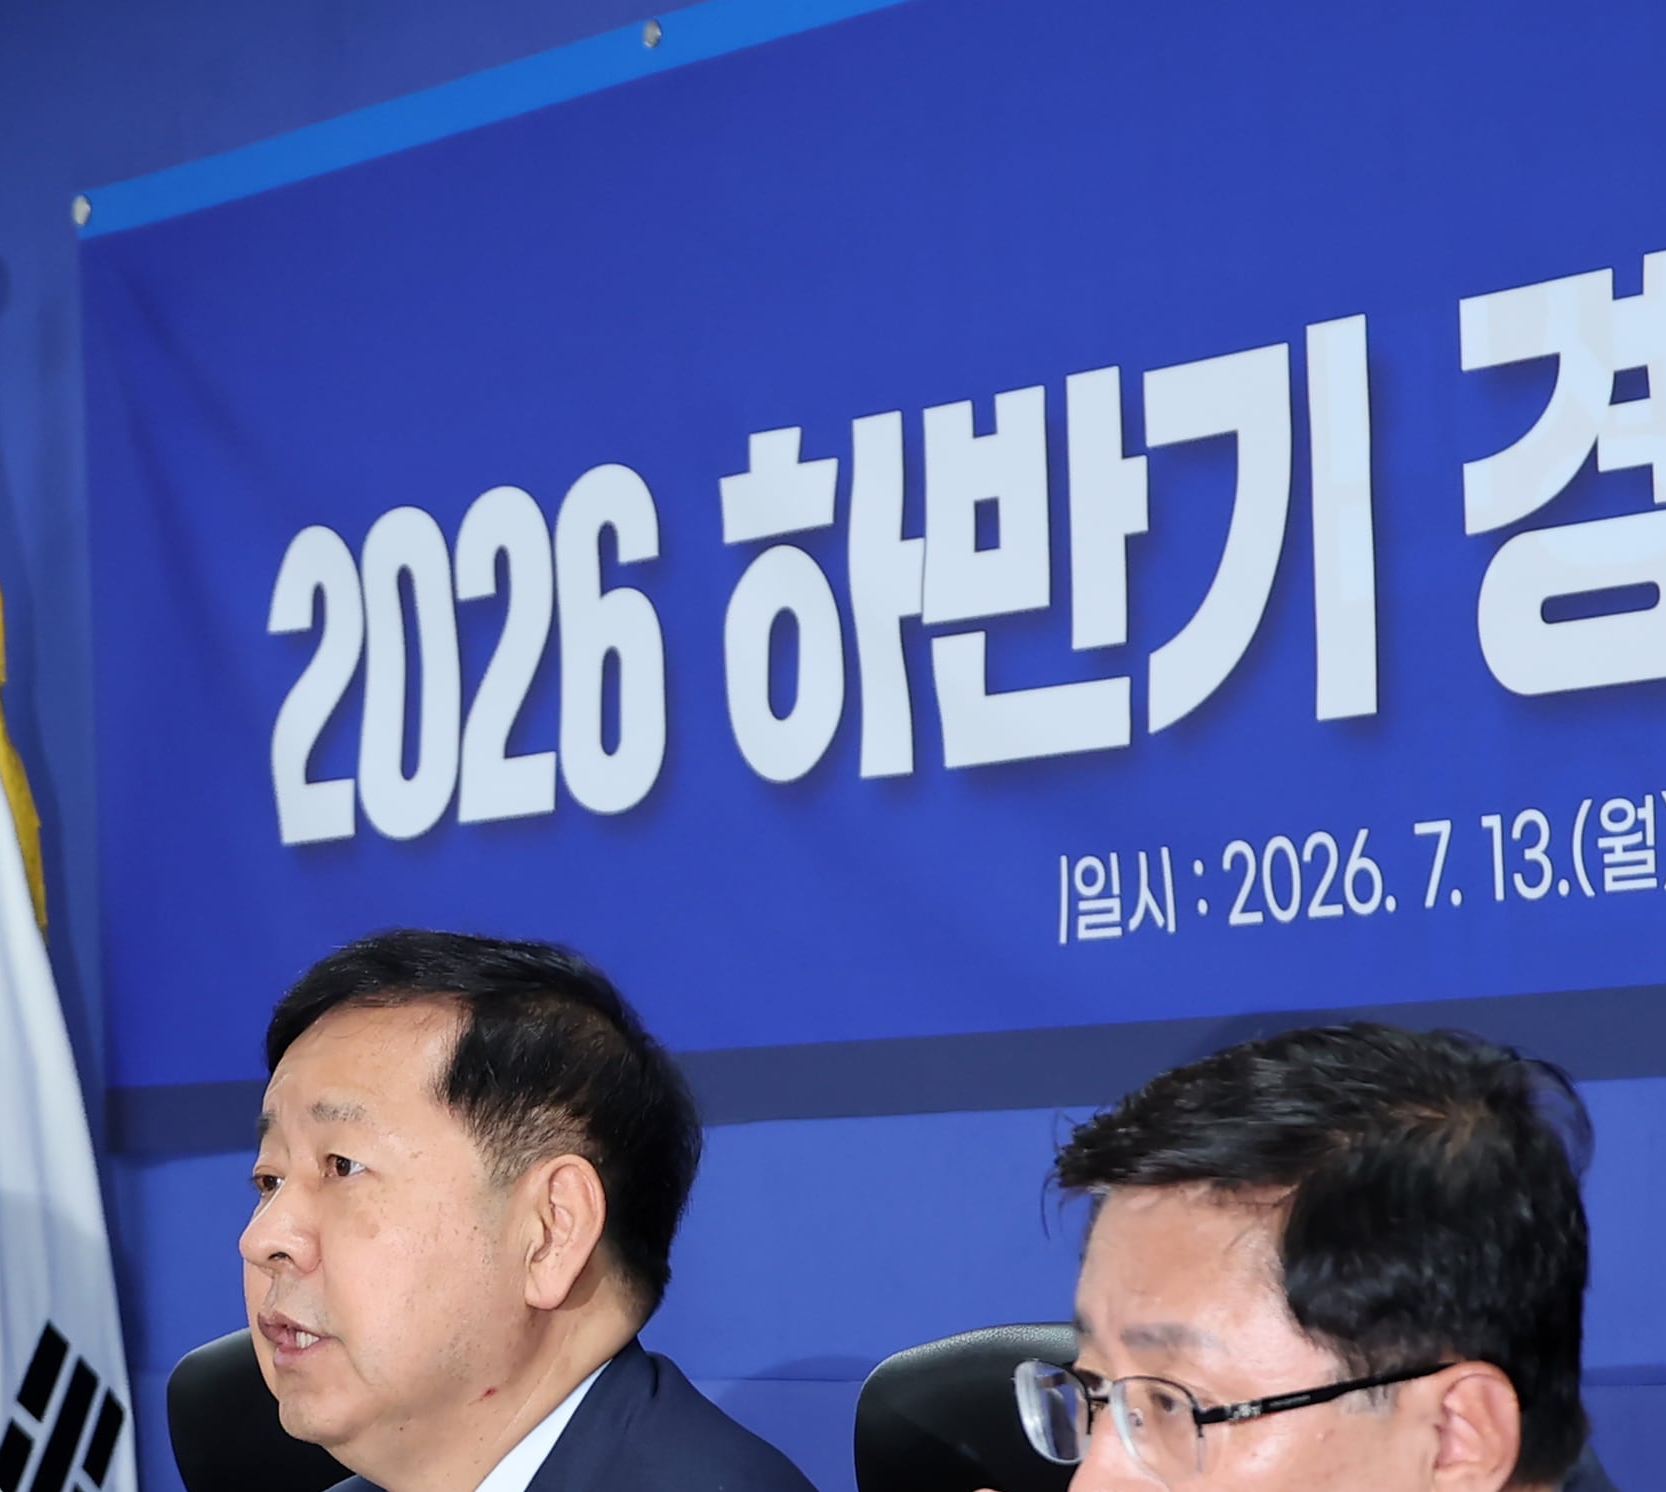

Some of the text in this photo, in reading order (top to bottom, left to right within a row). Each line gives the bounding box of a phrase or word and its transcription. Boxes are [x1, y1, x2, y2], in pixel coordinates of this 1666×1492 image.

[268, 464, 665, 844] 2026
[720, 314, 1376, 782] 하반기
[1223, 829, 1395, 925] 2026.
[1414, 820, 1461, 907] 7.
